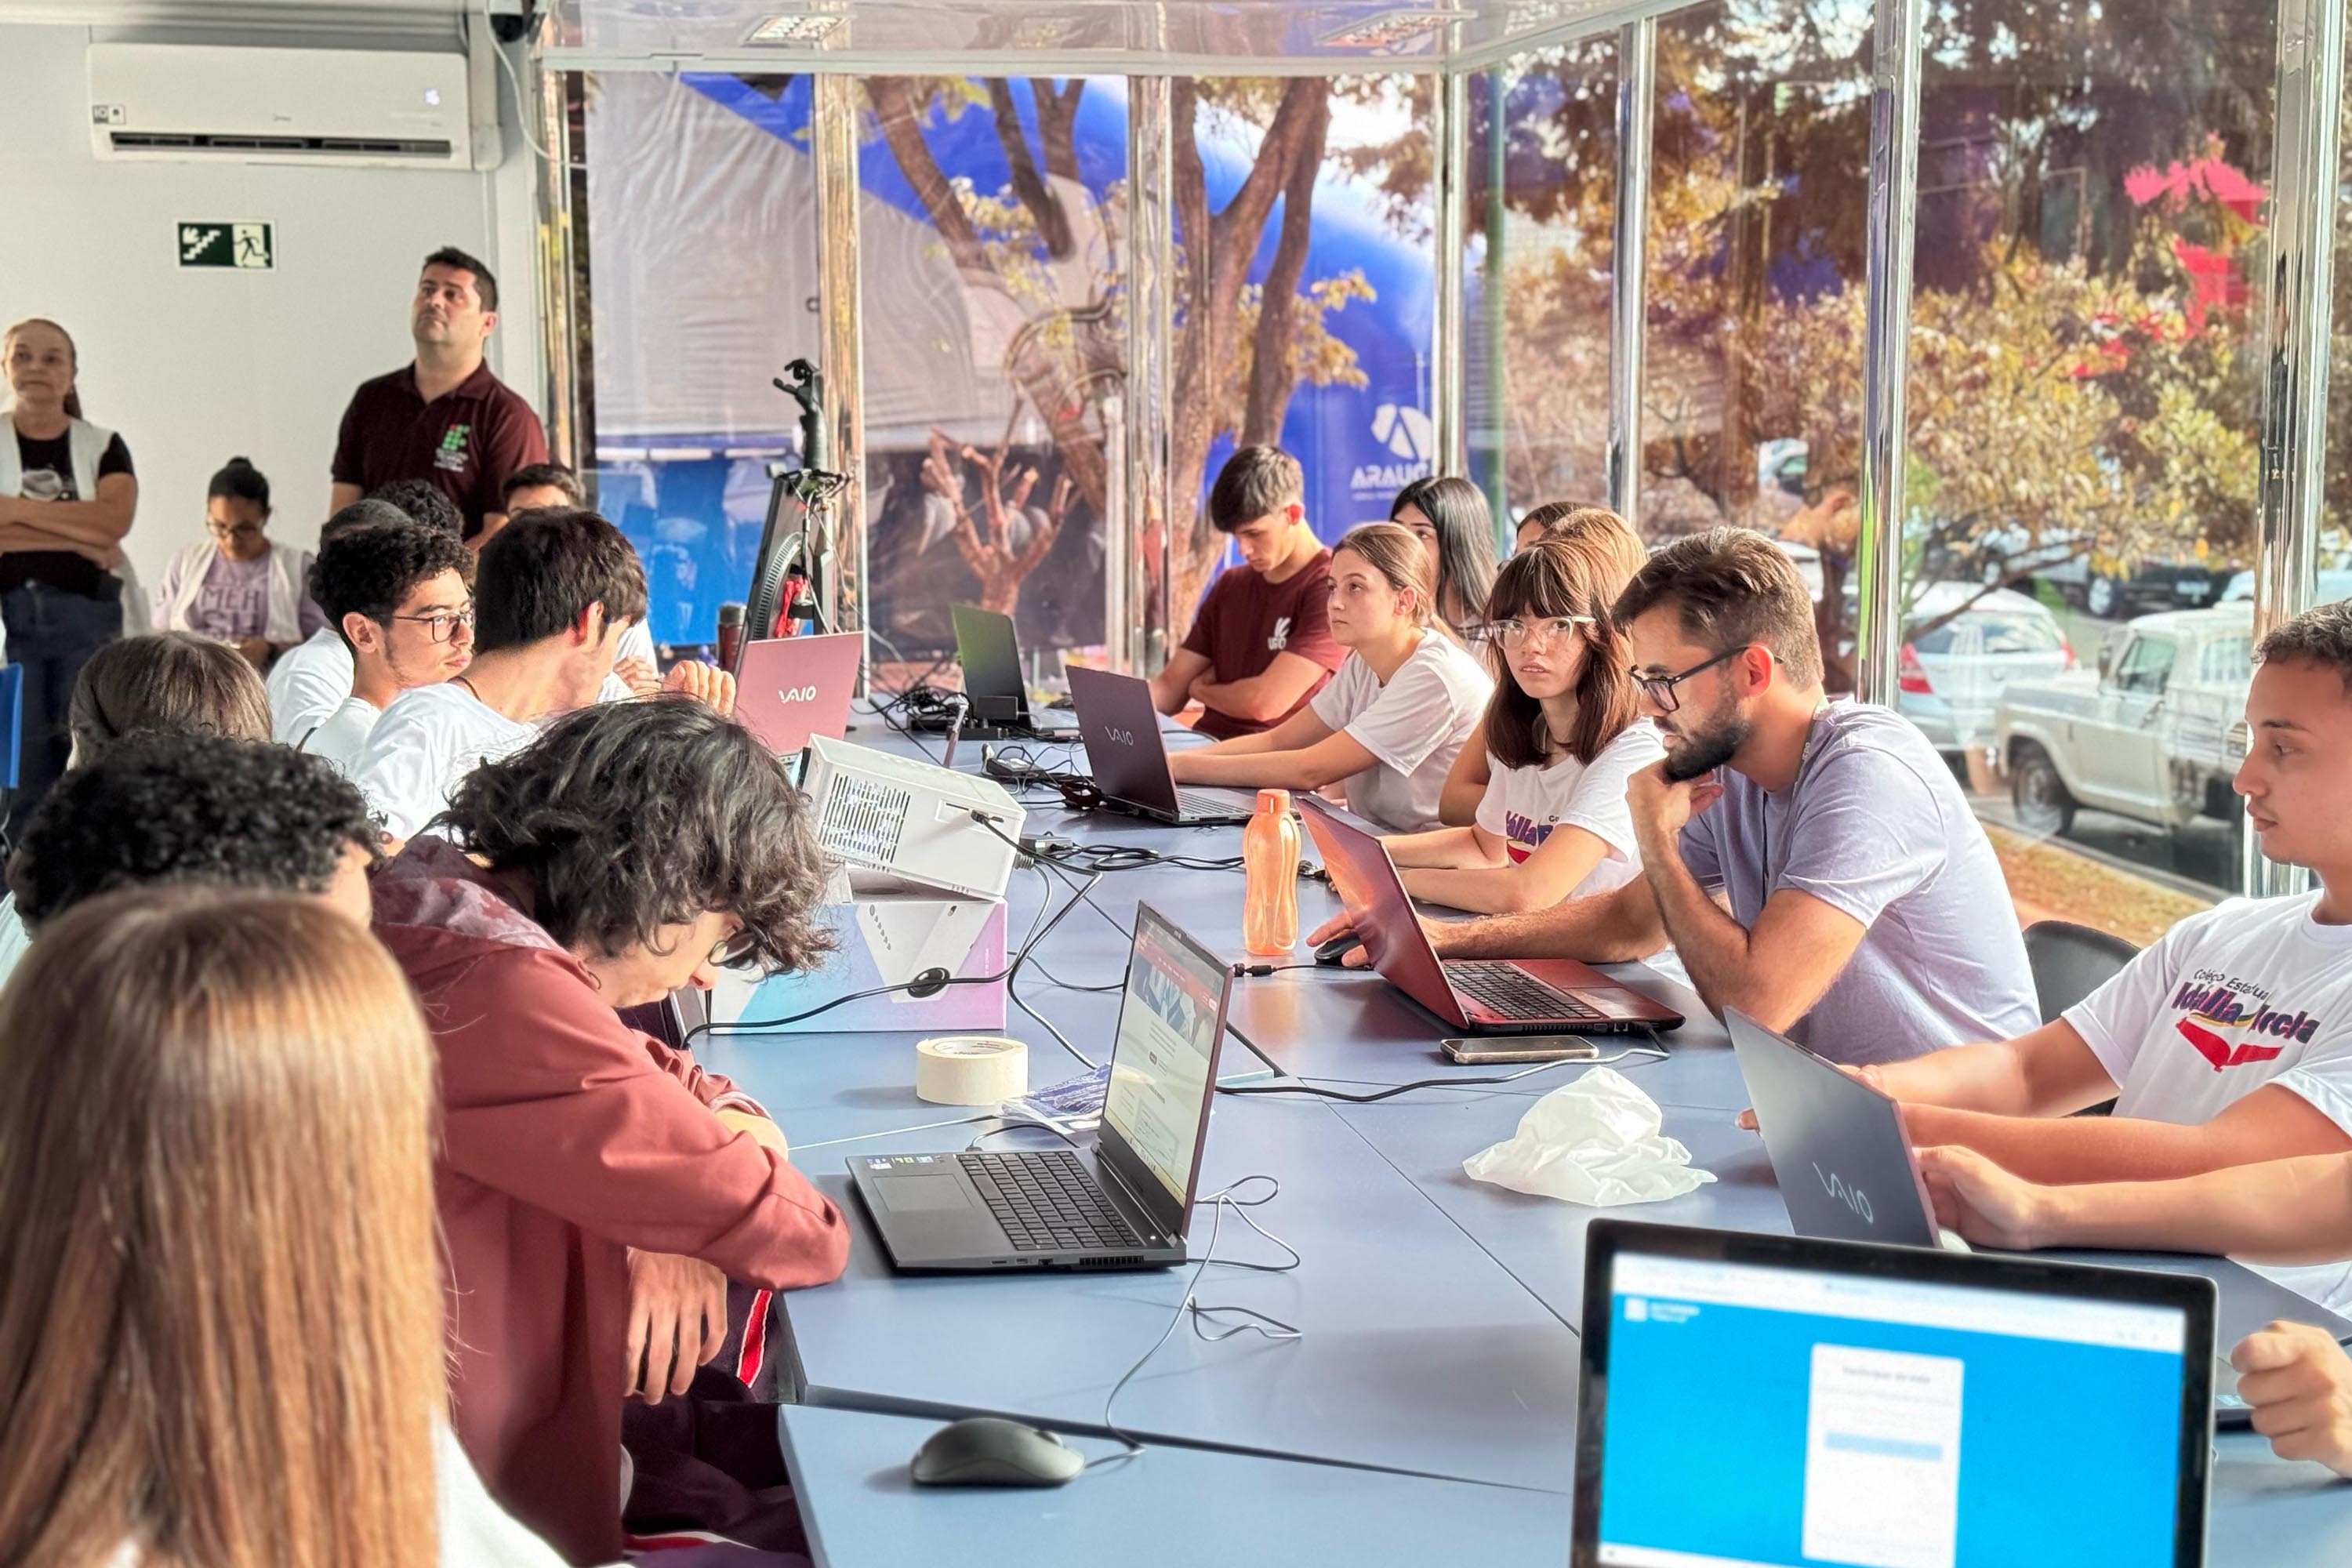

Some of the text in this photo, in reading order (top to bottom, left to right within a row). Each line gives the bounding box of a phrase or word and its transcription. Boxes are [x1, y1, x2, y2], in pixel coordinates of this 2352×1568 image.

[1350, 462, 1428, 488] ARAUC
[778, 685, 817, 704] VAIO
[1105, 725, 1134, 746] VAIO
[1812, 1160, 1874, 1224] VAIO
